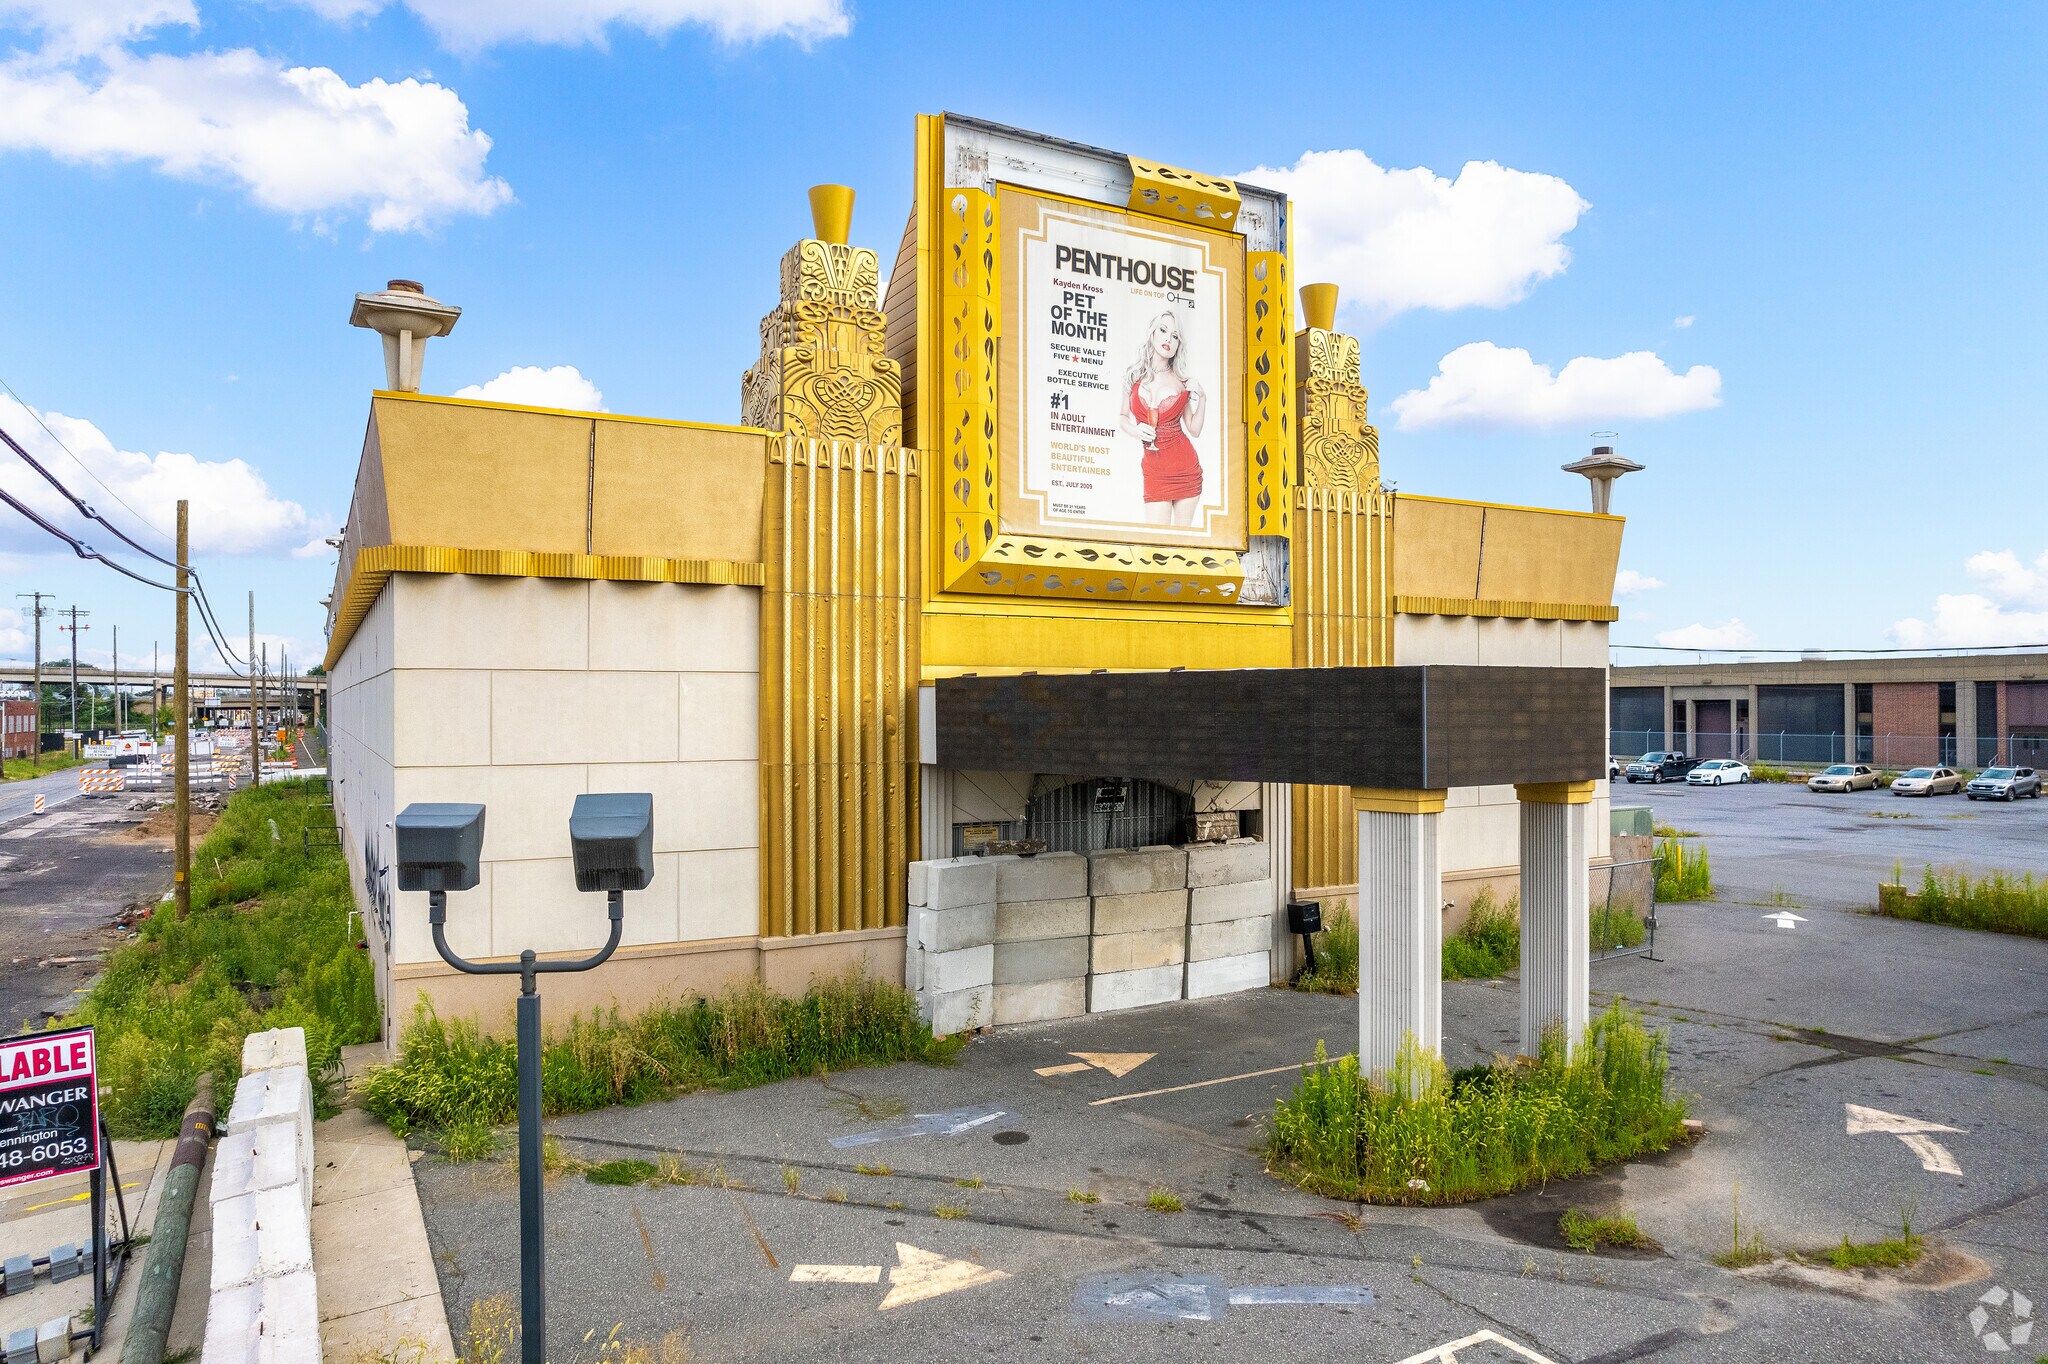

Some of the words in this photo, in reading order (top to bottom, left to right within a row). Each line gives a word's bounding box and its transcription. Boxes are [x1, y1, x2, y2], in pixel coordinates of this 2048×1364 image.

[1056, 244, 1196, 294] PENTHOUSE
[1053, 278, 1081, 289] Kayden
[1083, 283, 1104, 294] Kross
[1063, 291, 1096, 309] PET
[1050, 305, 1073, 321] OF
[1076, 309, 1108, 327] THE
[1051, 320, 1107, 343] MONTH
[1050, 343, 1081, 354] SECURE
[1082, 348, 1106, 357] VALET
[1053, 353, 1070, 361] FIVE
[1081, 357, 1104, 366] MENU
[1058, 369, 1099, 381] EXECUTIVE
[1047, 376, 1076, 386] BOTTLE
[1078, 380, 1109, 391] SERVICE
[1050, 393, 1069, 410] #1
[1050, 411, 1059, 420] IN
[1061, 413, 1086, 423] ADULT
[1050, 422, 1116, 438] ENTERTAINMENT
[1050, 441, 1086, 453] WORLD'S
[1088, 446, 1110, 455] MOST
[1051, 452, 1095, 464] BEAUTIFUL
[1051, 463, 1111, 476] ENTERTAINERS
